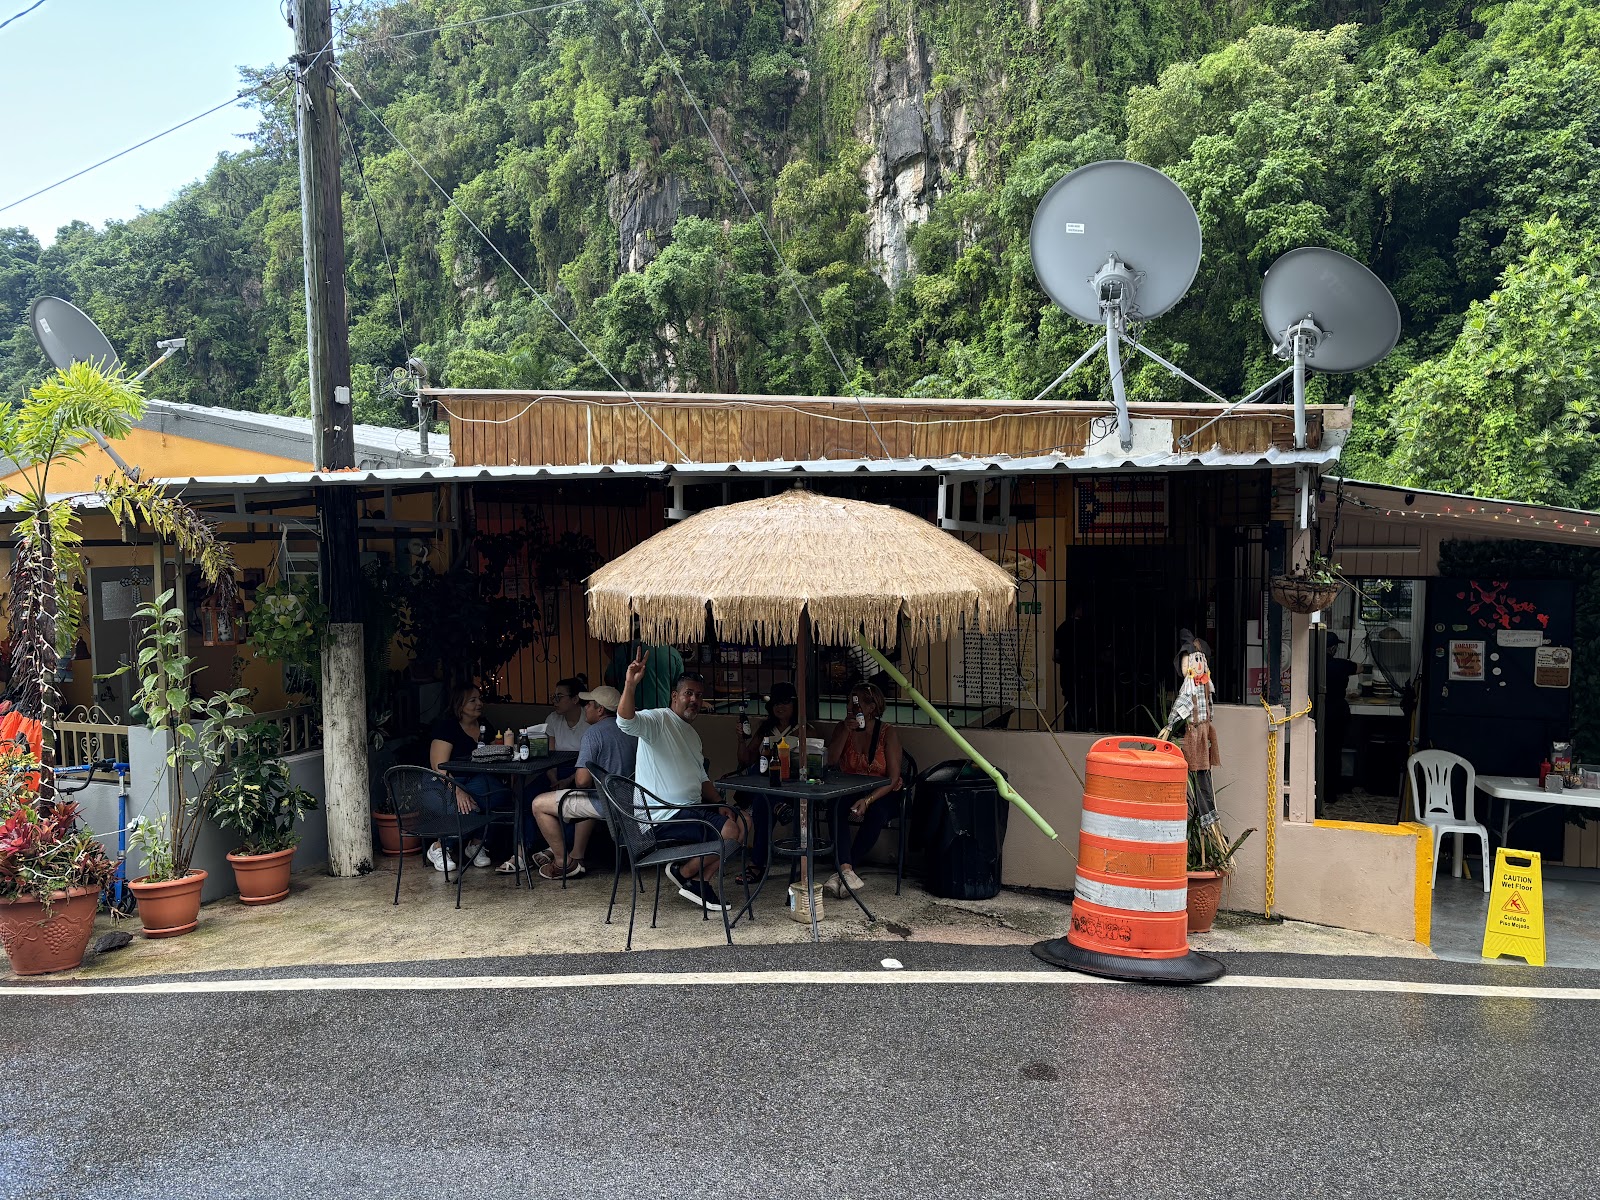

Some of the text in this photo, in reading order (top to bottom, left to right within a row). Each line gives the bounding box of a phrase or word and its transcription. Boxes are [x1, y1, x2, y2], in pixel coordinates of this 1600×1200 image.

[1504, 874, 1532, 884] CAUTION
[1502, 881, 1532, 891] Wet Floor
[1504, 914, 1526, 923] Cuidado
[1512, 922, 1530, 930] Mojado
